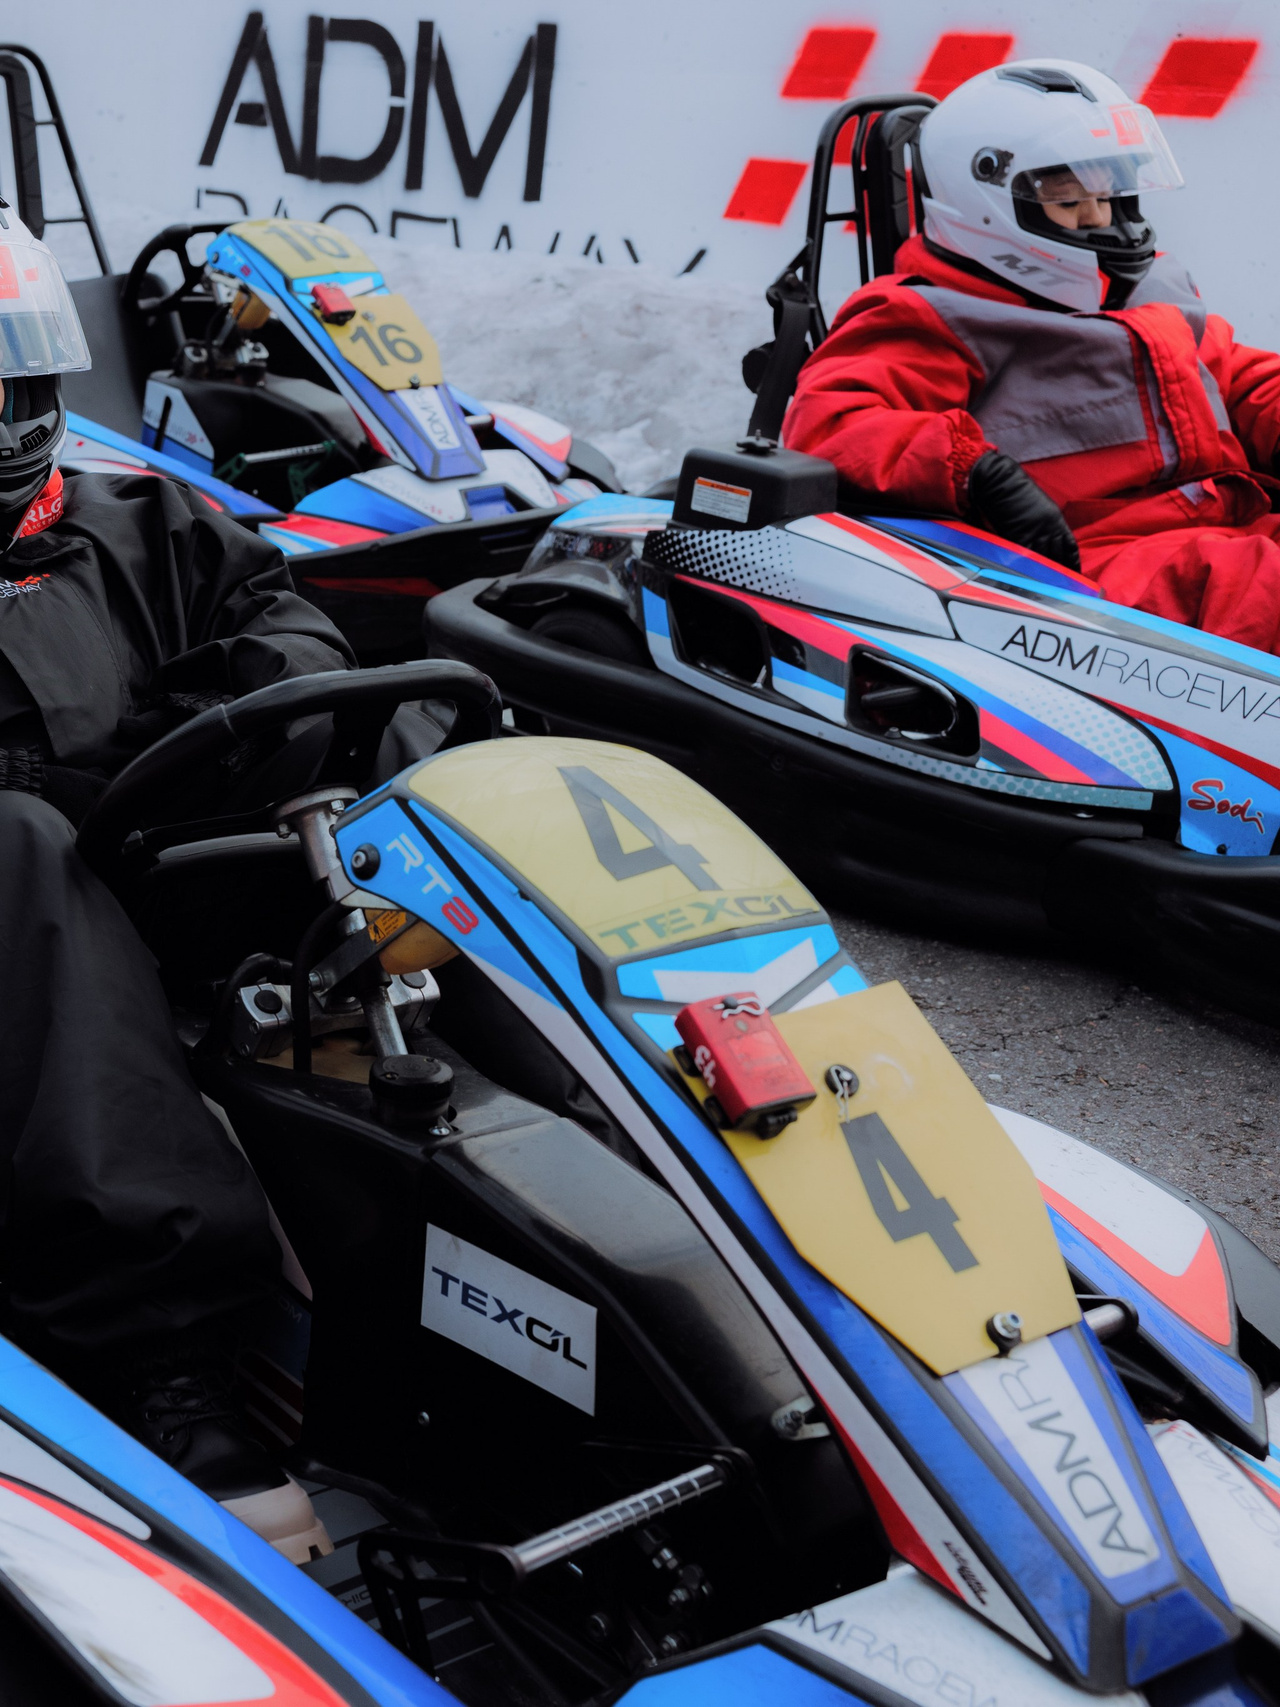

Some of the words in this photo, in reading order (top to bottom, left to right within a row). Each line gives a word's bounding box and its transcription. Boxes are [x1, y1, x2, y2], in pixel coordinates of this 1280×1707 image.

[198, 11, 558, 202] ADM
[263, 223, 350, 262] 16
[349, 324, 423, 367] 16
[557, 765, 724, 892] 4
[1187, 779, 1265, 834] Sodi
[385, 832, 480, 935] RT8
[839, 1111, 980, 1273] 4
